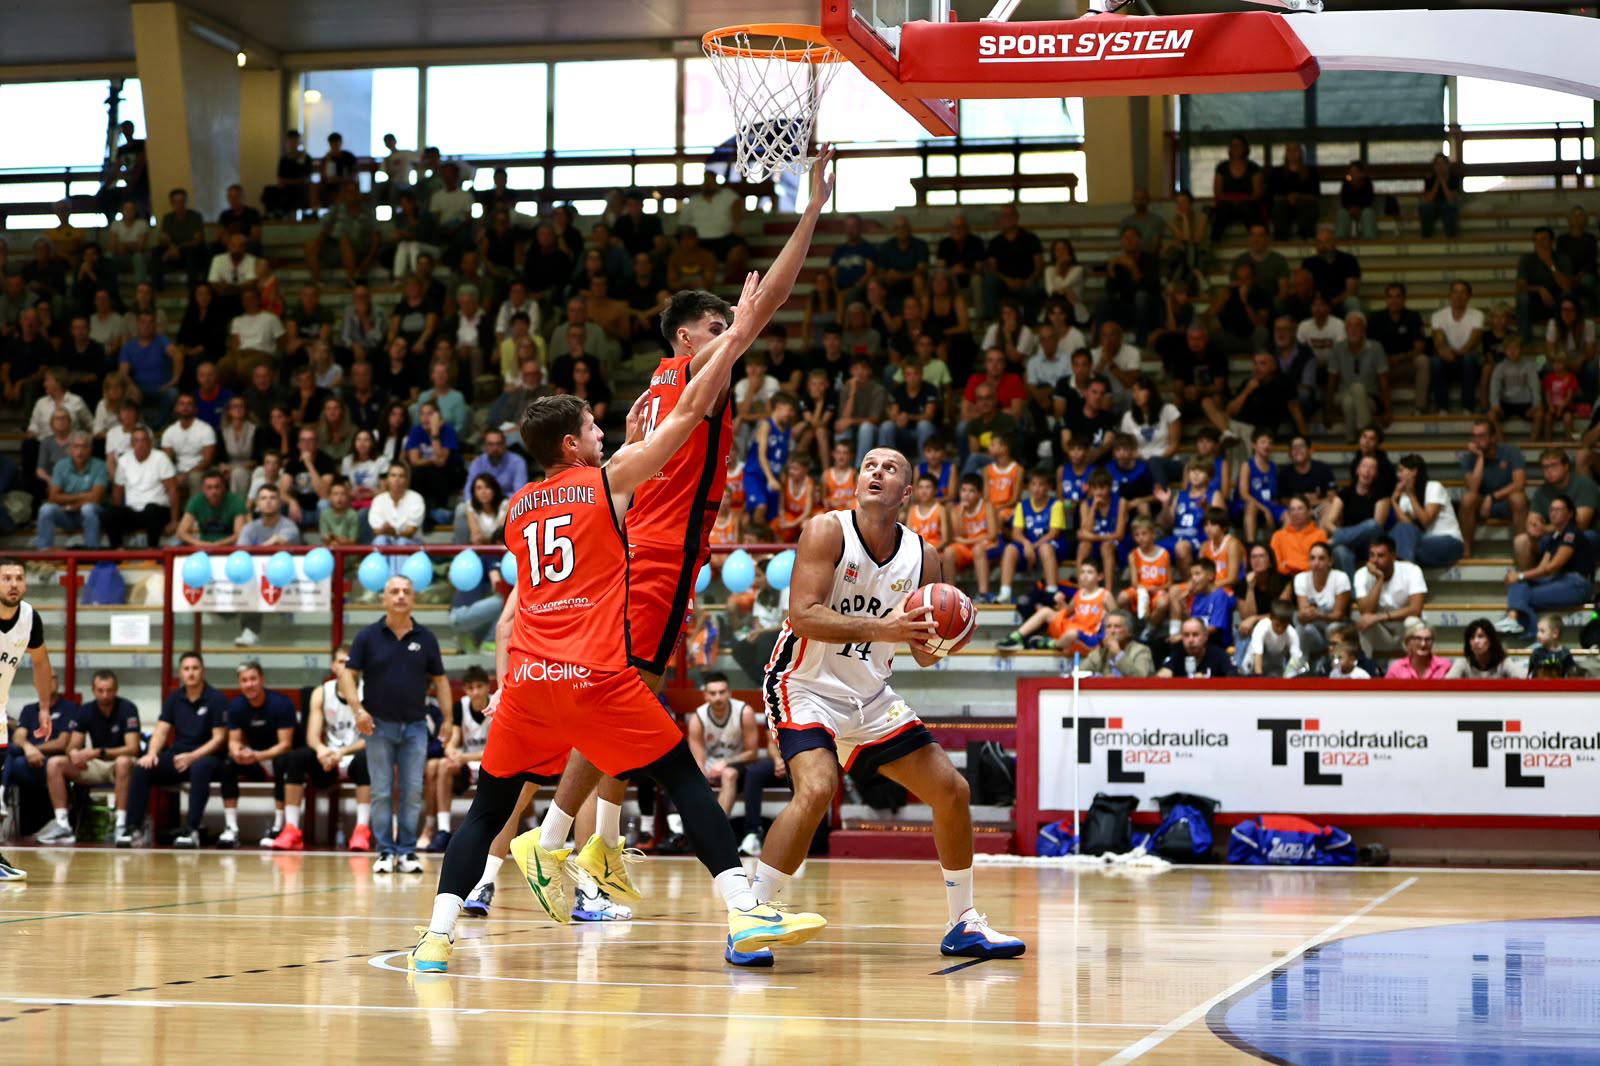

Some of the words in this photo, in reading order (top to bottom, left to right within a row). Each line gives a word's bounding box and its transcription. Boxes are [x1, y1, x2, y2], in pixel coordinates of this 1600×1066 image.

[978, 34, 1074, 56] SPORT
[1075, 29, 1194, 61] SYSTEM
[509, 485, 597, 523] MONFALCONE
[521, 512, 576, 589] 15
[836, 641, 872, 662] 14
[1062, 717, 1229, 764] Termoidraulica
[1257, 718, 1428, 766] Termoidraulica
[1107, 749, 1172, 784] Lanza
[1304, 751, 1369, 786] Lanza
[1505, 753, 1572, 788] Lanza
